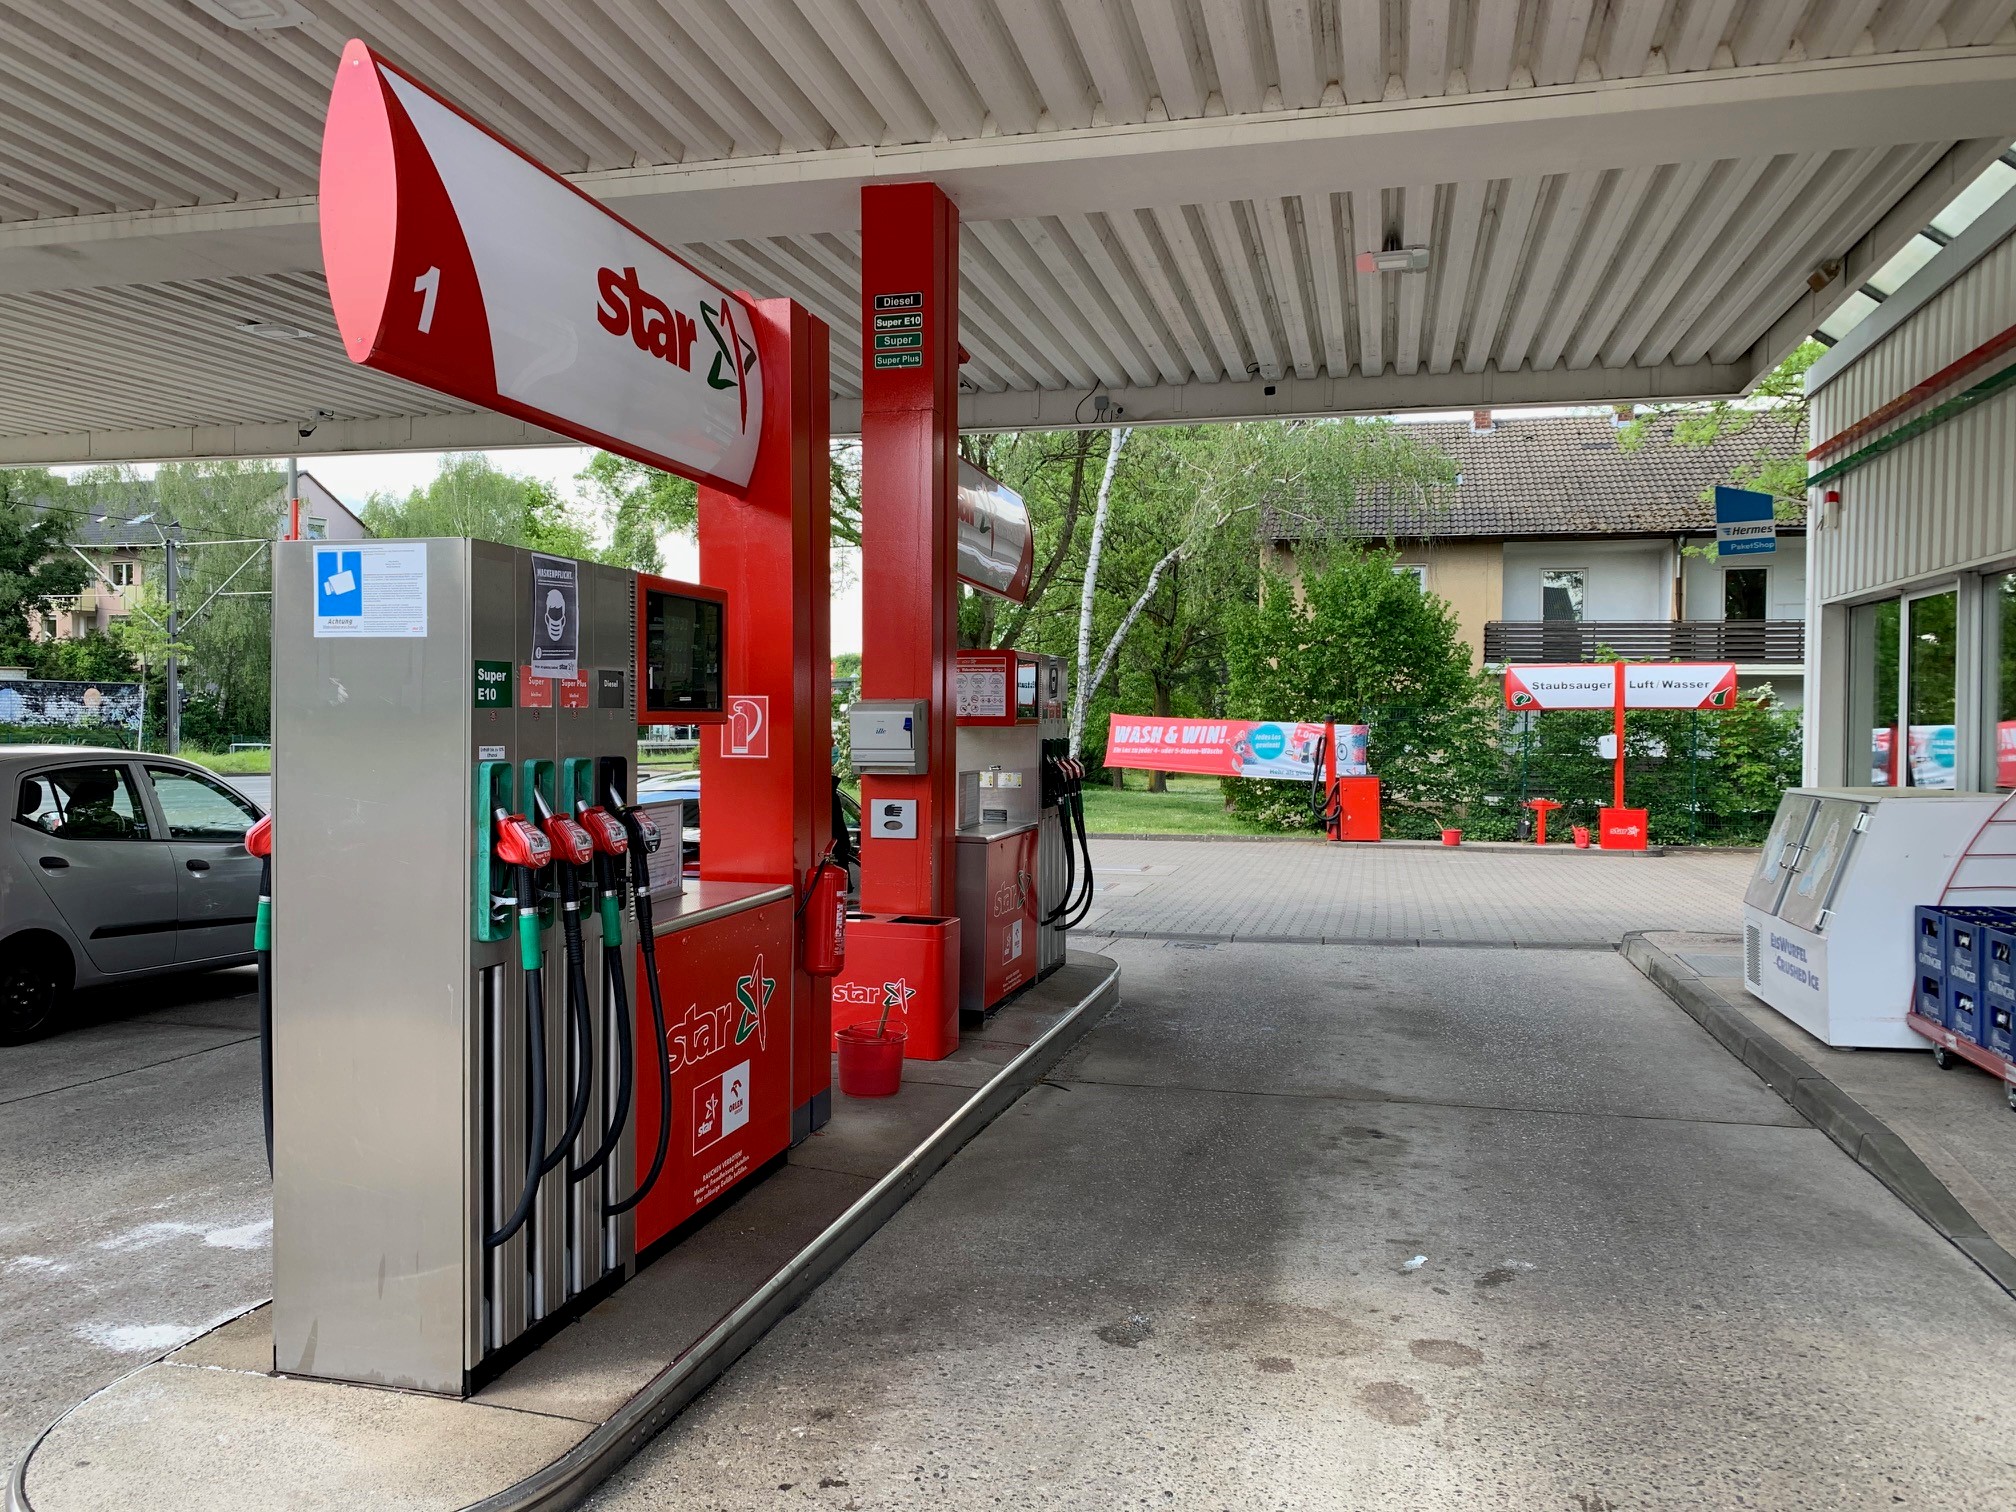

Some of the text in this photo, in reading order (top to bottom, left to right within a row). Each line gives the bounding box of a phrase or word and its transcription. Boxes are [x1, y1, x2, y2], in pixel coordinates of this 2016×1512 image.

[414, 266, 440, 334] 1
[884, 296, 914, 306] Diesel
[596, 266, 698, 373] star
[876, 316, 920, 328] Super E10
[884, 336, 912, 346] Super
[878, 357, 900, 365] Super
[1732, 525, 1773, 536] Hermes
[1730, 542, 1774, 550] PaketShop
[478, 668, 506, 684] Super
[528, 676, 544, 686] Super
[562, 680, 576, 688] Super
[604, 680, 618, 688] Diesel
[1532, 681, 1612, 692] Staubsauger
[478, 688, 496, 700] E10
[1114, 726, 1228, 744] WASH & WIN!
[994, 880, 1017, 918] star
[1776, 955, 1820, 992] CRUSHED ICE
[832, 982, 880, 1004] star
[666, 1002, 732, 1074] star
[729, 1098, 744, 1112] ORLEN
[698, 1120, 714, 1137] star
